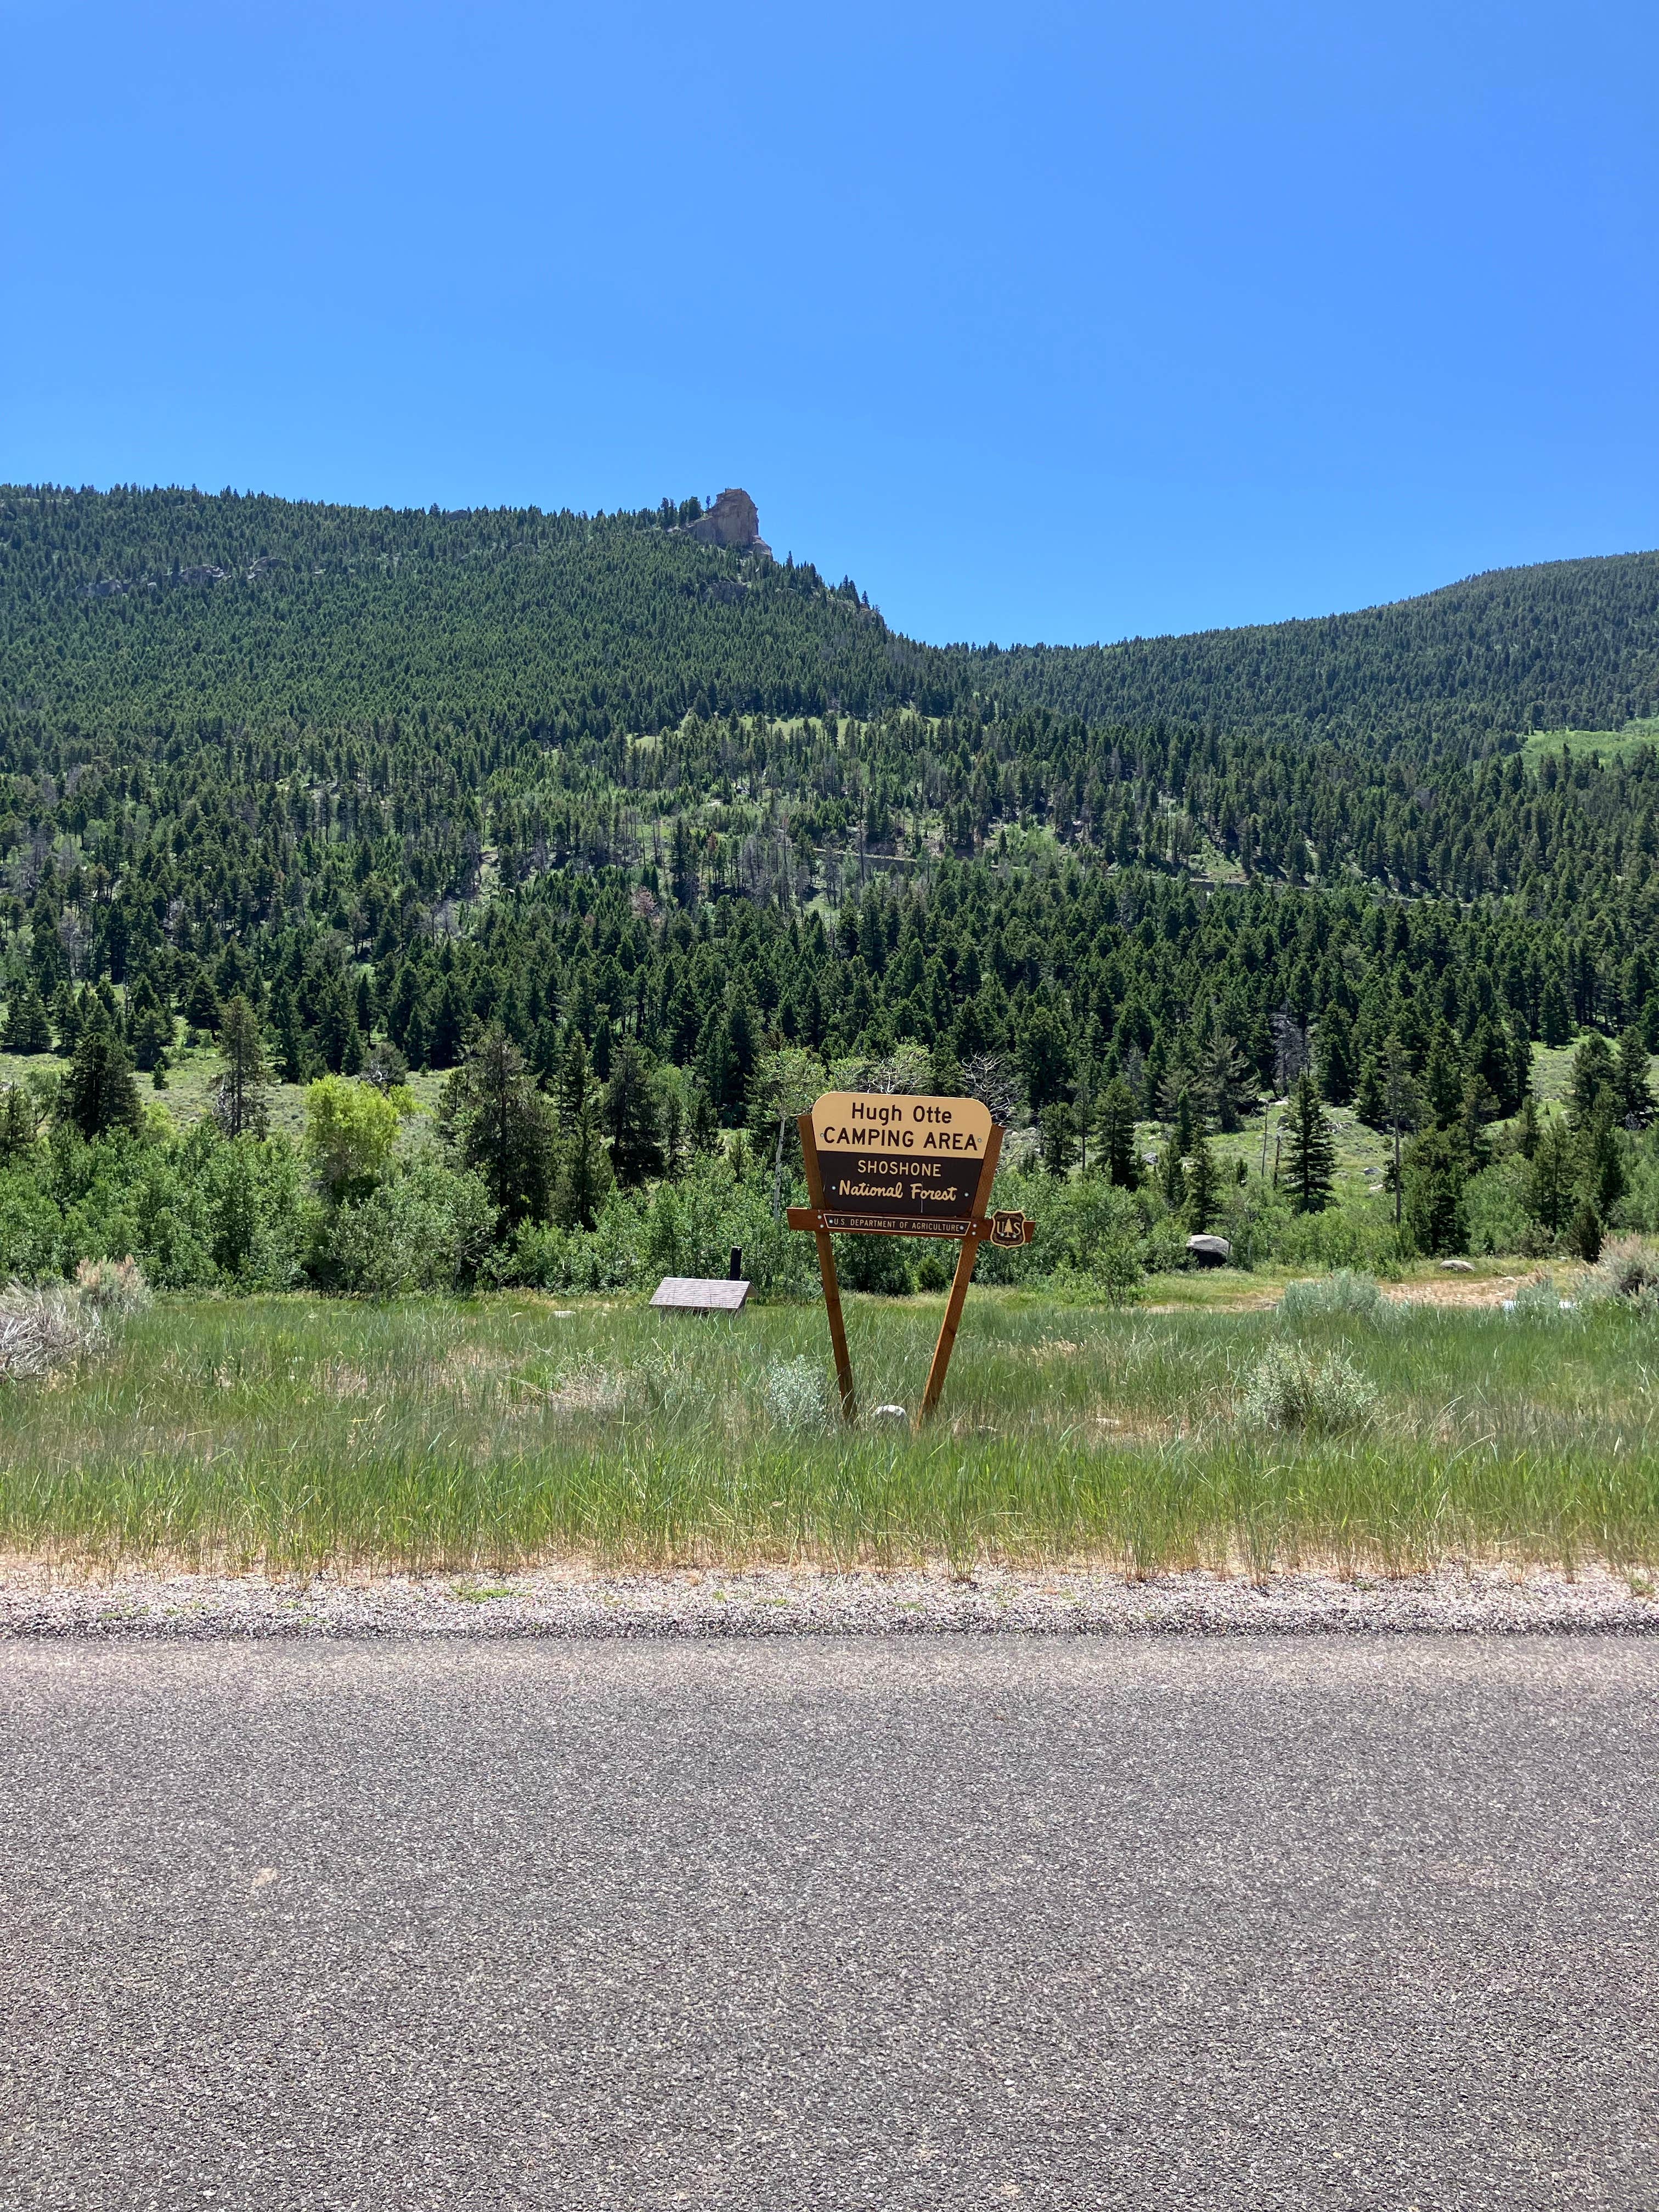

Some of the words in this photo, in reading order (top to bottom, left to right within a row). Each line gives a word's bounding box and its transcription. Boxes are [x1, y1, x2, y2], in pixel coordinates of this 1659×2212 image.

[851, 1102, 902, 1125] Hugh
[912, 1105, 952, 1124] Otte
[824, 1126, 915, 1148] CAMPING
[923, 1132, 978, 1151] AREA
[857, 1160, 941, 1177] SHOSHONE
[839, 1180, 903, 1199] National
[910, 1183, 957, 1201] Forest
[850, 1218, 895, 1228] DEPARTMENT
[912, 1222, 960, 1232] AGRICULTURE
